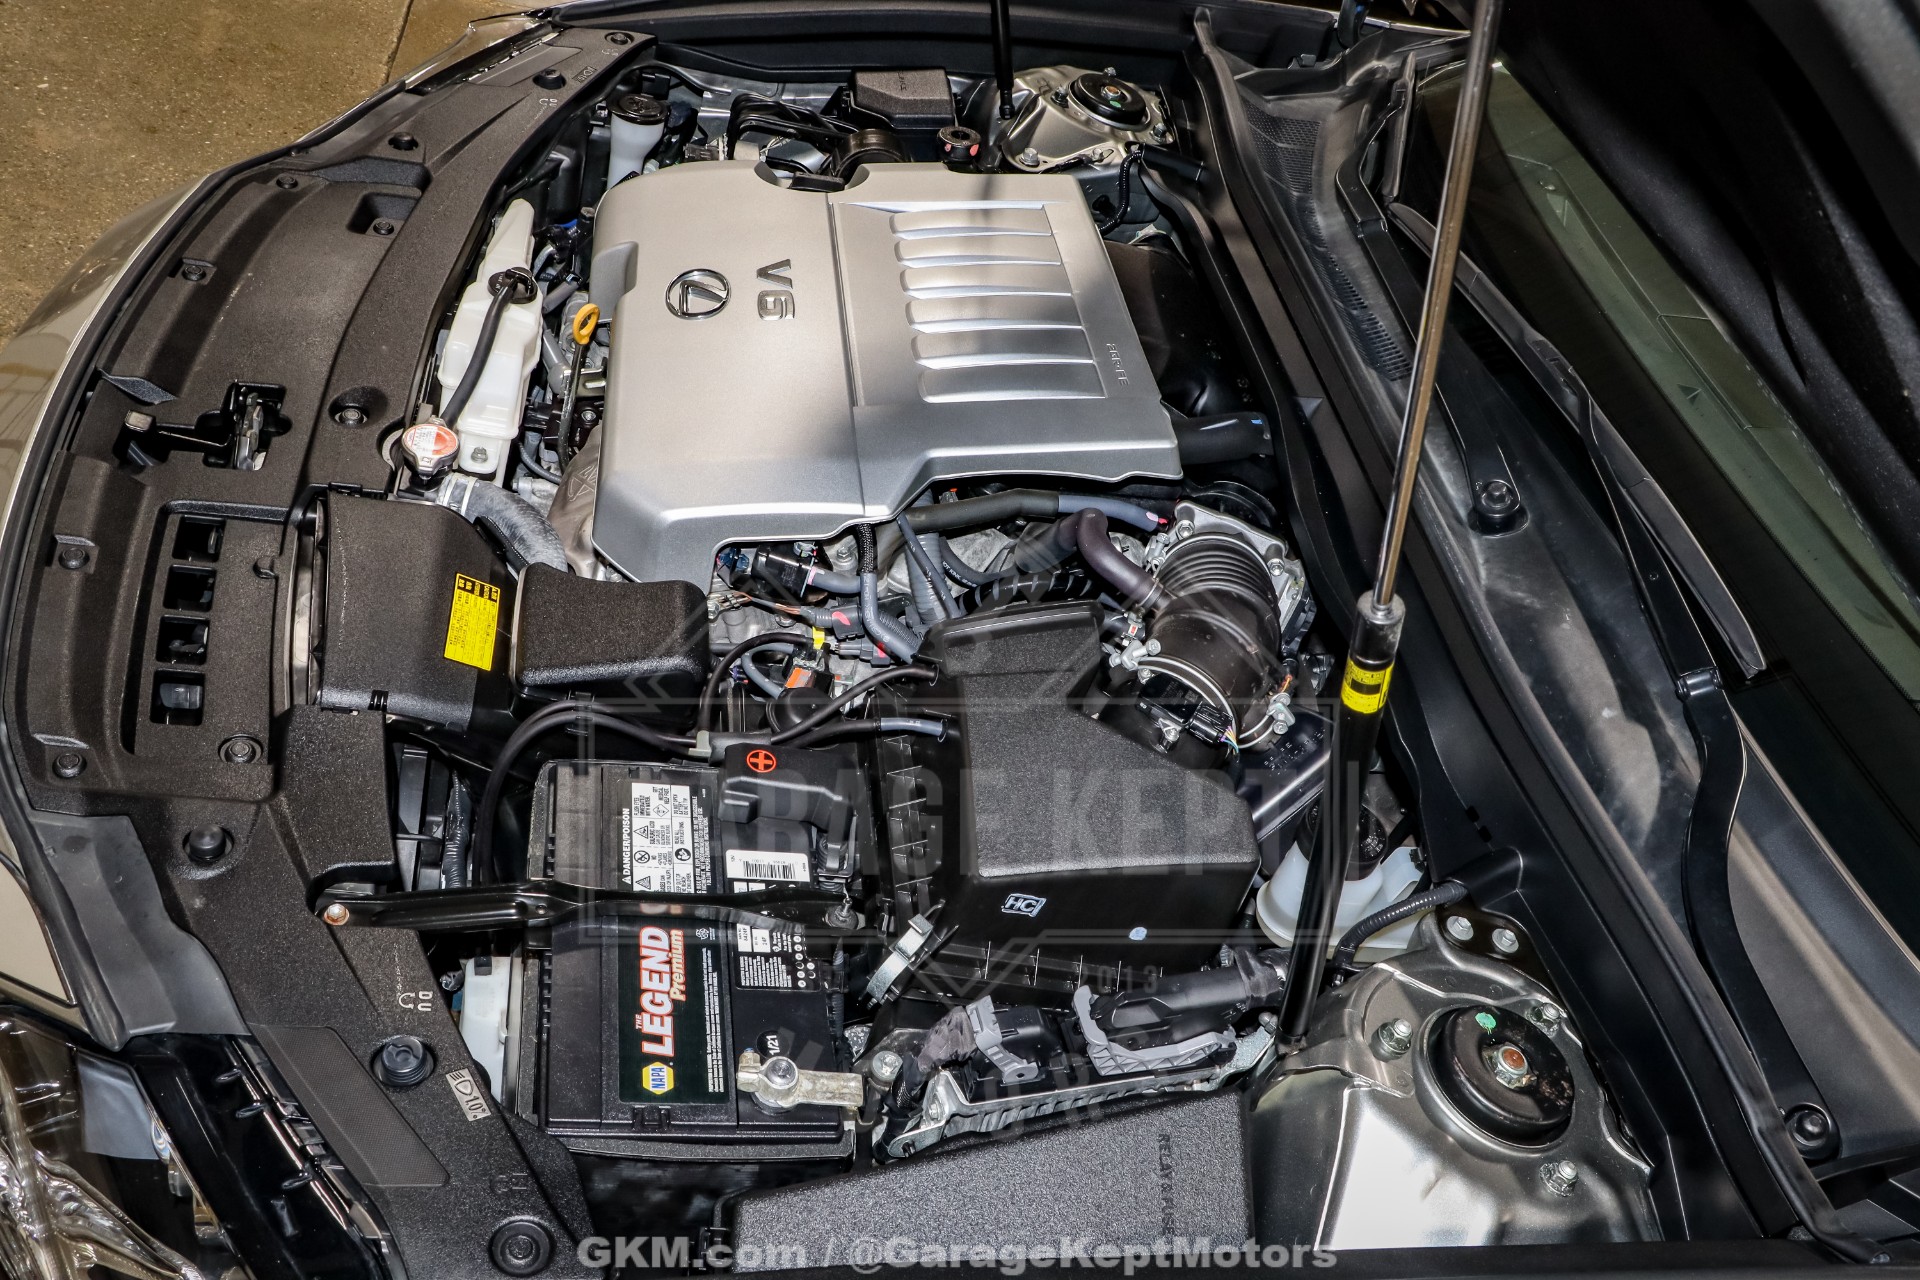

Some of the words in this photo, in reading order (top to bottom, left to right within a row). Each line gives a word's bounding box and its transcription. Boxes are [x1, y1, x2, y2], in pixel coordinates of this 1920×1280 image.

[757, 259, 796, 322] V6
[622, 808, 631, 876] DANGER/POISON
[640, 926, 675, 1057] LEGEND
[668, 928, 687, 1002] Premium
[765, 1035, 781, 1056] 1/21
[649, 1067, 667, 1090] NAPA
[1156, 1133, 1173, 1181] RELAY
